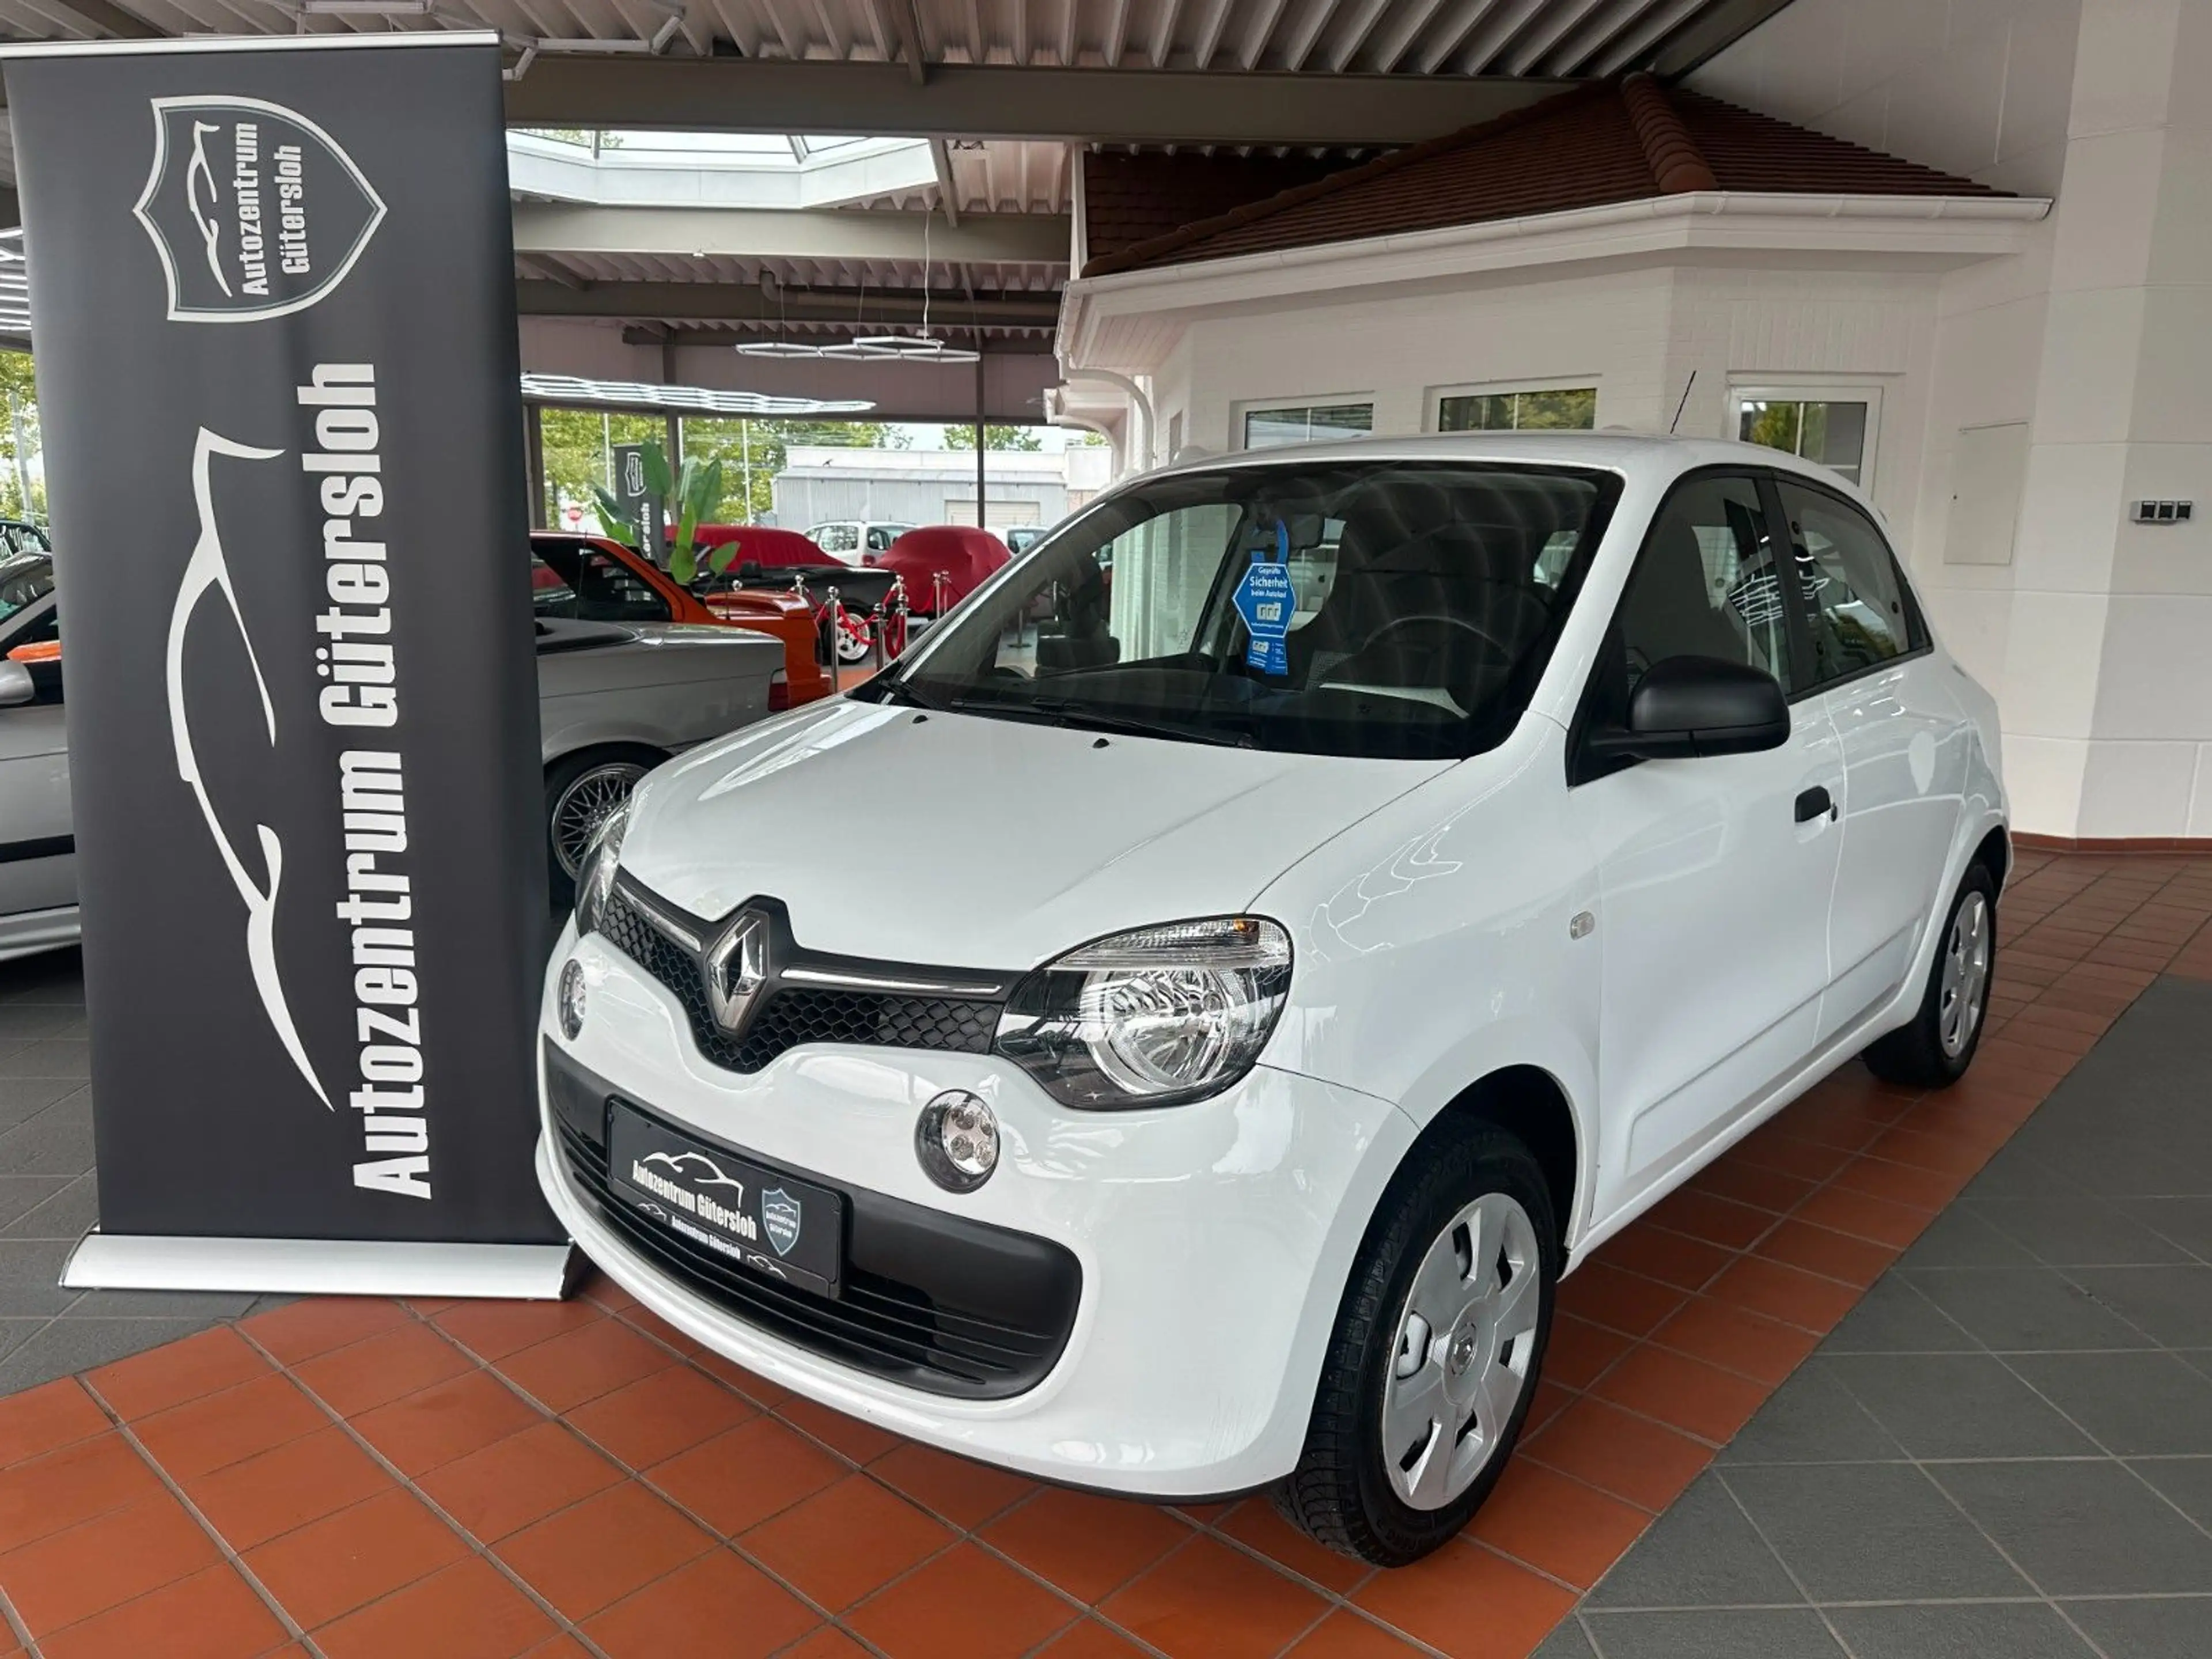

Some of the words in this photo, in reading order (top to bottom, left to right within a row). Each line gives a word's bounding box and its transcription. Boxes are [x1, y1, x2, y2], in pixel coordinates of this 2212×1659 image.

[233, 122, 269, 296] Autozentrum
[274, 145, 310, 275] Gütersloh
[297, 363, 398, 727] Gütersloh
[1249, 576, 1287, 588] Sicherheit
[336, 750, 432, 1200] Autozentrum
[632, 1160, 696, 1212] Autozentrum
[696, 1193, 757, 1241] Gütersloh
[672, 1215, 709, 1245] Autozentrum
[709, 1234, 741, 1260] Gütersloh
